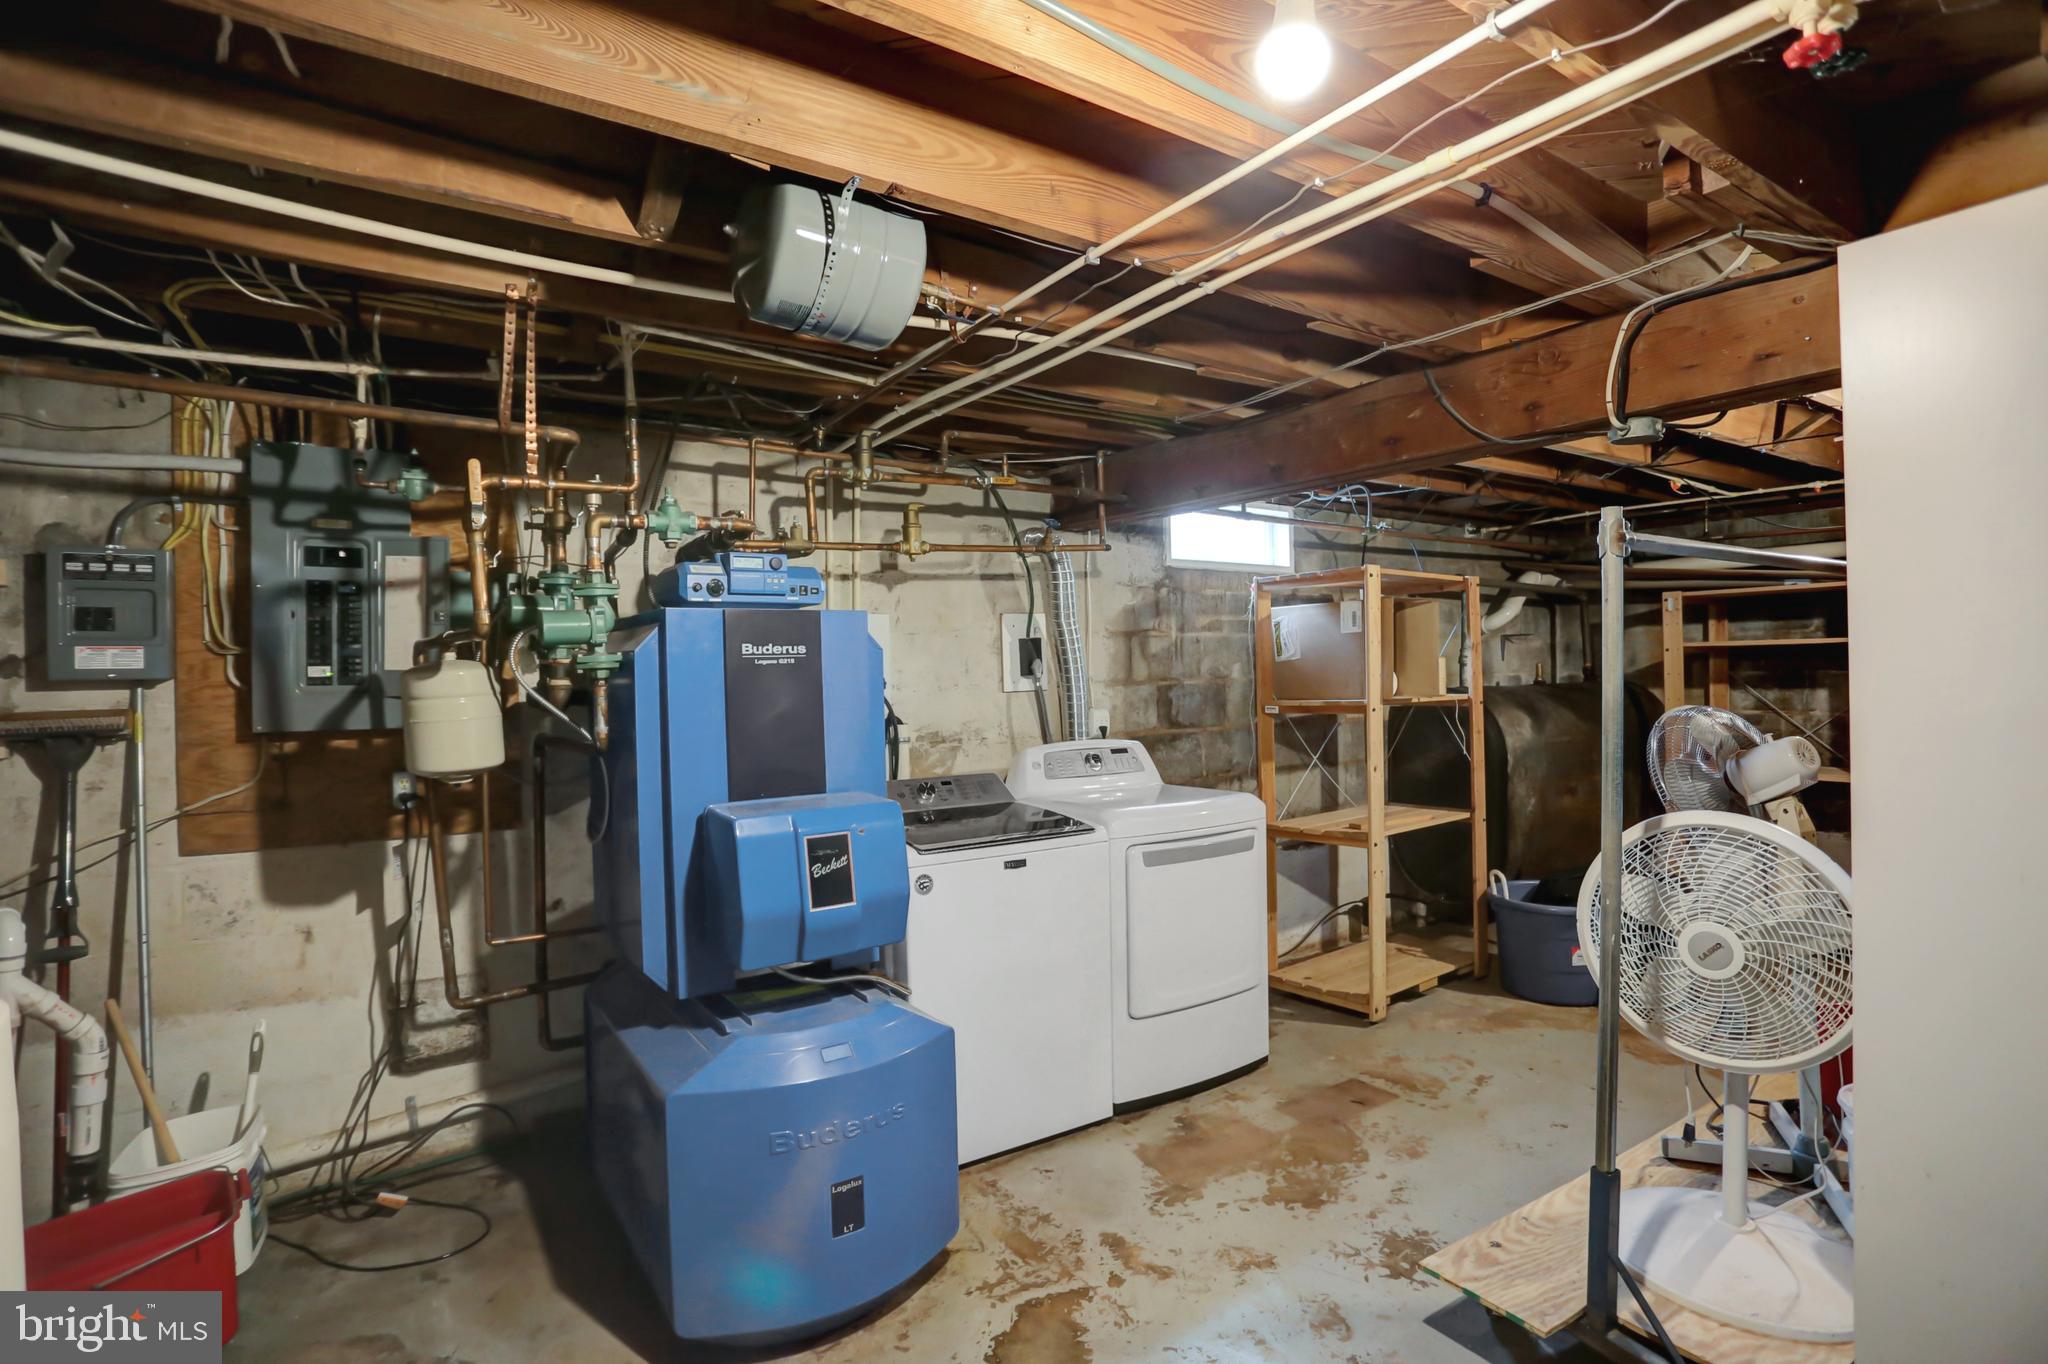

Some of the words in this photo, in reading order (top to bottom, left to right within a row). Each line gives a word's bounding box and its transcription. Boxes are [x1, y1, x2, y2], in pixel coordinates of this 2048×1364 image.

[741, 643, 807, 654] Buderus
[811, 854, 849, 878] Beckett
[769, 1102, 905, 1156] Buderus
[843, 1223, 854, 1233] LT
